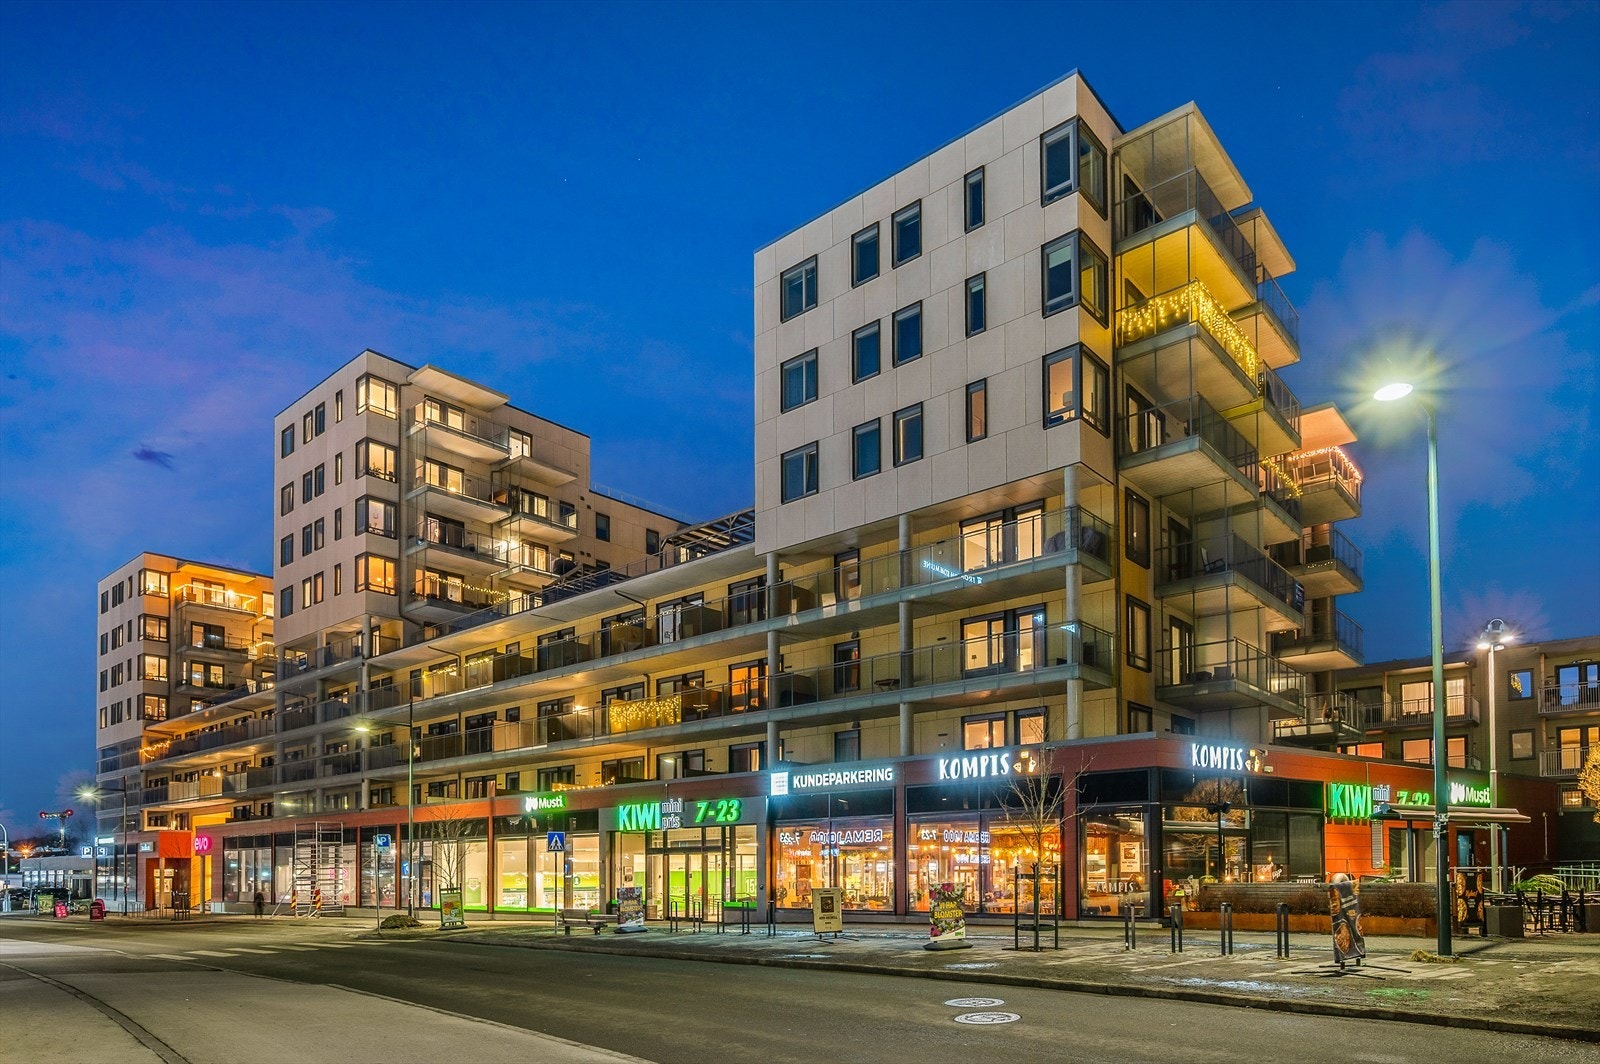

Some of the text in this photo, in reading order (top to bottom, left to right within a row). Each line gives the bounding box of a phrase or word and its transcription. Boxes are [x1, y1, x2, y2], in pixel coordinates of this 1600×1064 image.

[1192, 743, 1244, 770] KOMPIS
[939, 753, 1010, 780] KOMPIS
[793, 768, 893, 788] KUNDEPARKERING
[1331, 783, 1372, 818] KIWI
[1372, 784, 1390, 801] mini
[1465, 786, 1491, 803] Musti
[538, 795, 563, 809] Musti
[661, 798, 683, 813] mini
[618, 799, 741, 831] KIWI 7-23
[661, 813, 681, 831] pris
[194, 837, 209, 851] evo
[933, 909, 963, 919] BLOMSTER
